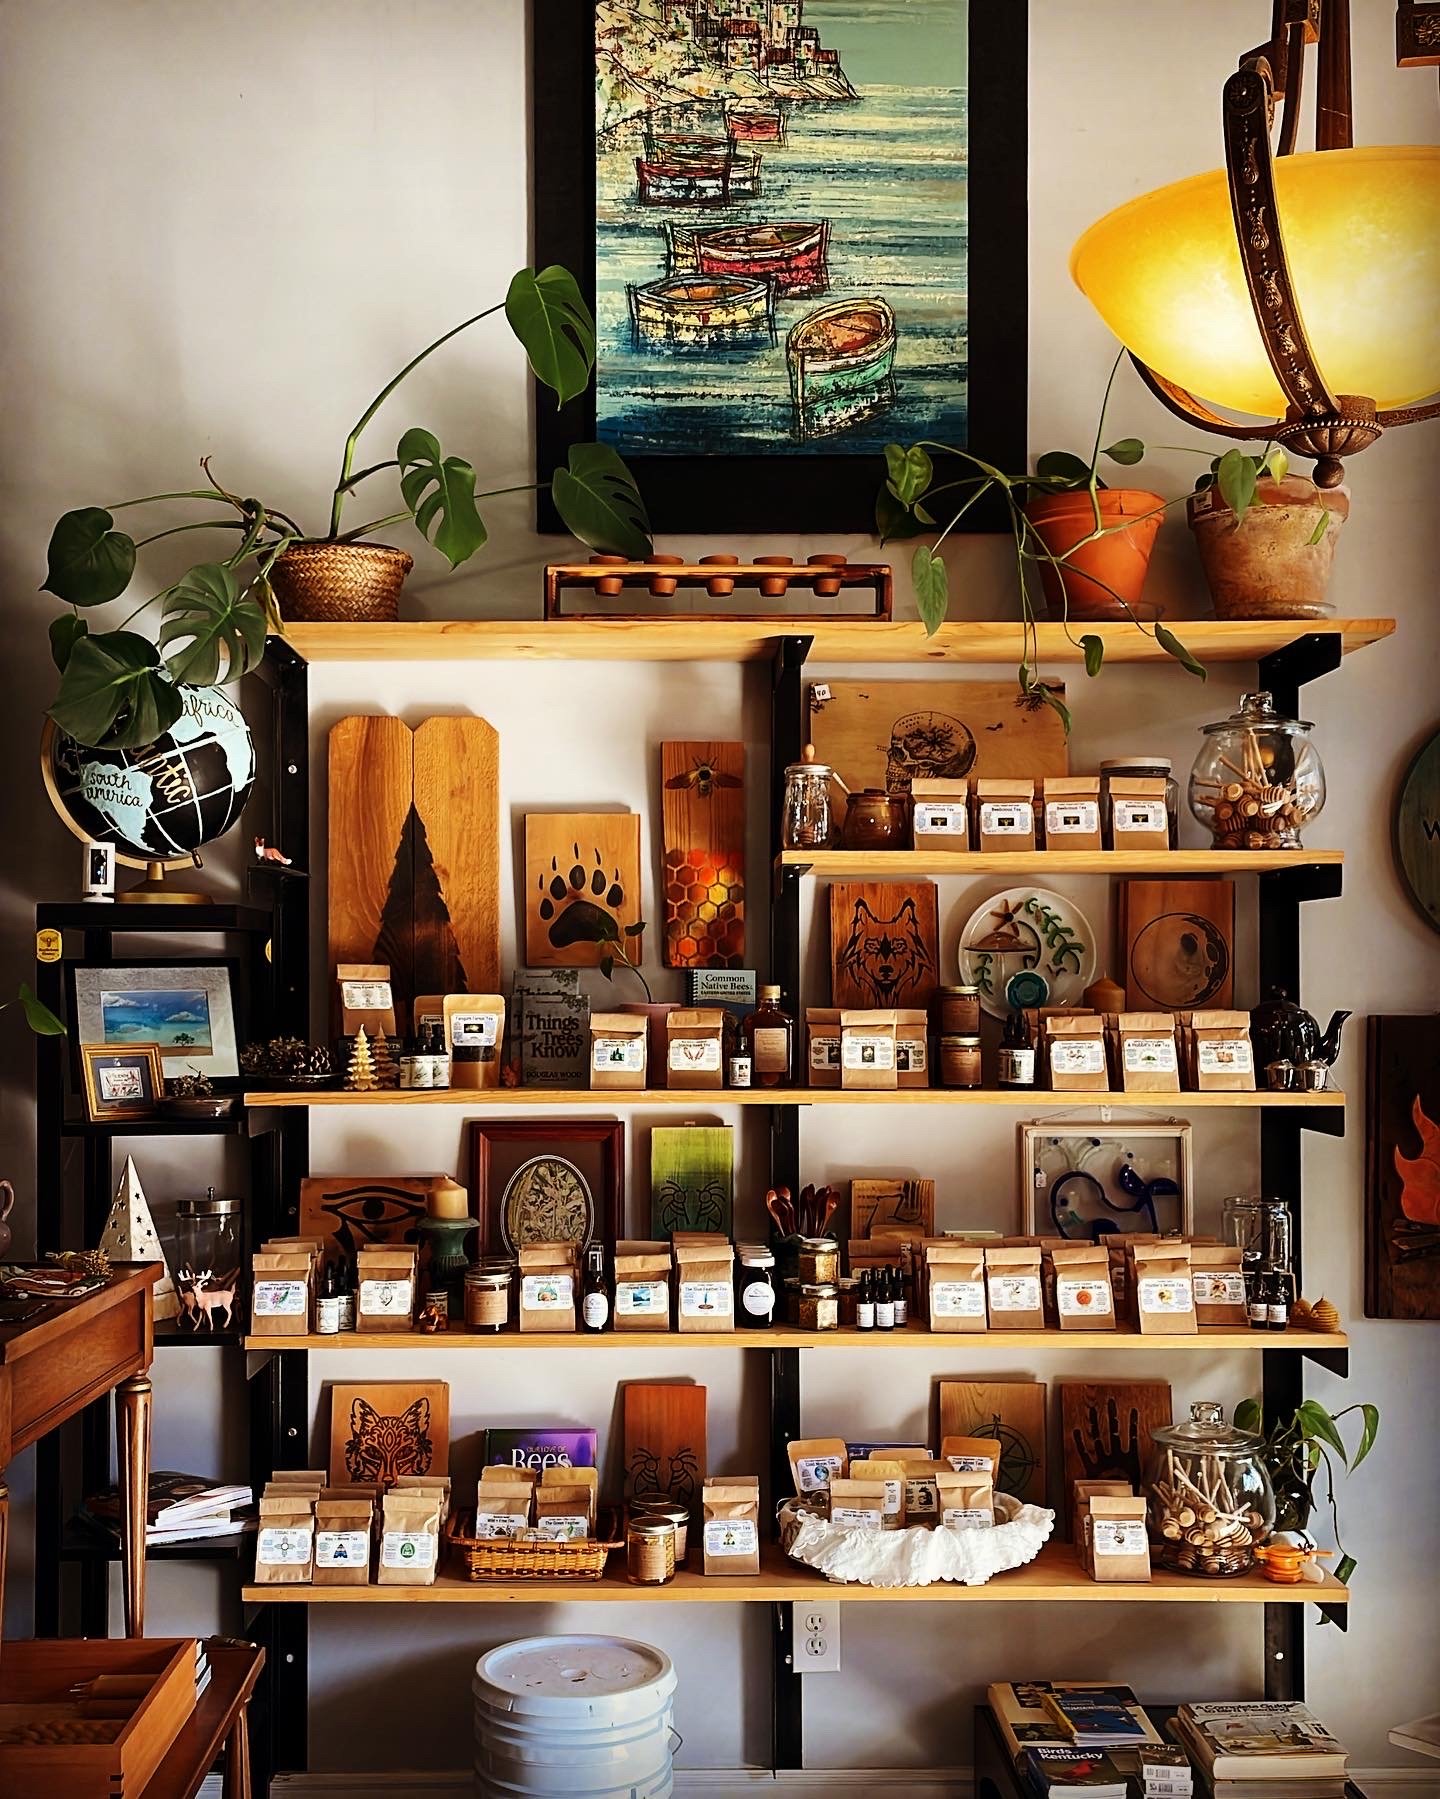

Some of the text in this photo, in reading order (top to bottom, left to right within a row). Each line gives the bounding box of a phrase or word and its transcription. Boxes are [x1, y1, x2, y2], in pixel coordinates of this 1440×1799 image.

[182, 695, 239, 728] africa
[89, 771, 132, 791] south
[86, 785, 143, 808] america
[701, 982, 750, 990] Native Bees
[705, 974, 745, 982] Common
[526, 1014, 579, 1034] Things
[542, 1031, 583, 1046] Trees
[531, 1042, 579, 1058] Know
